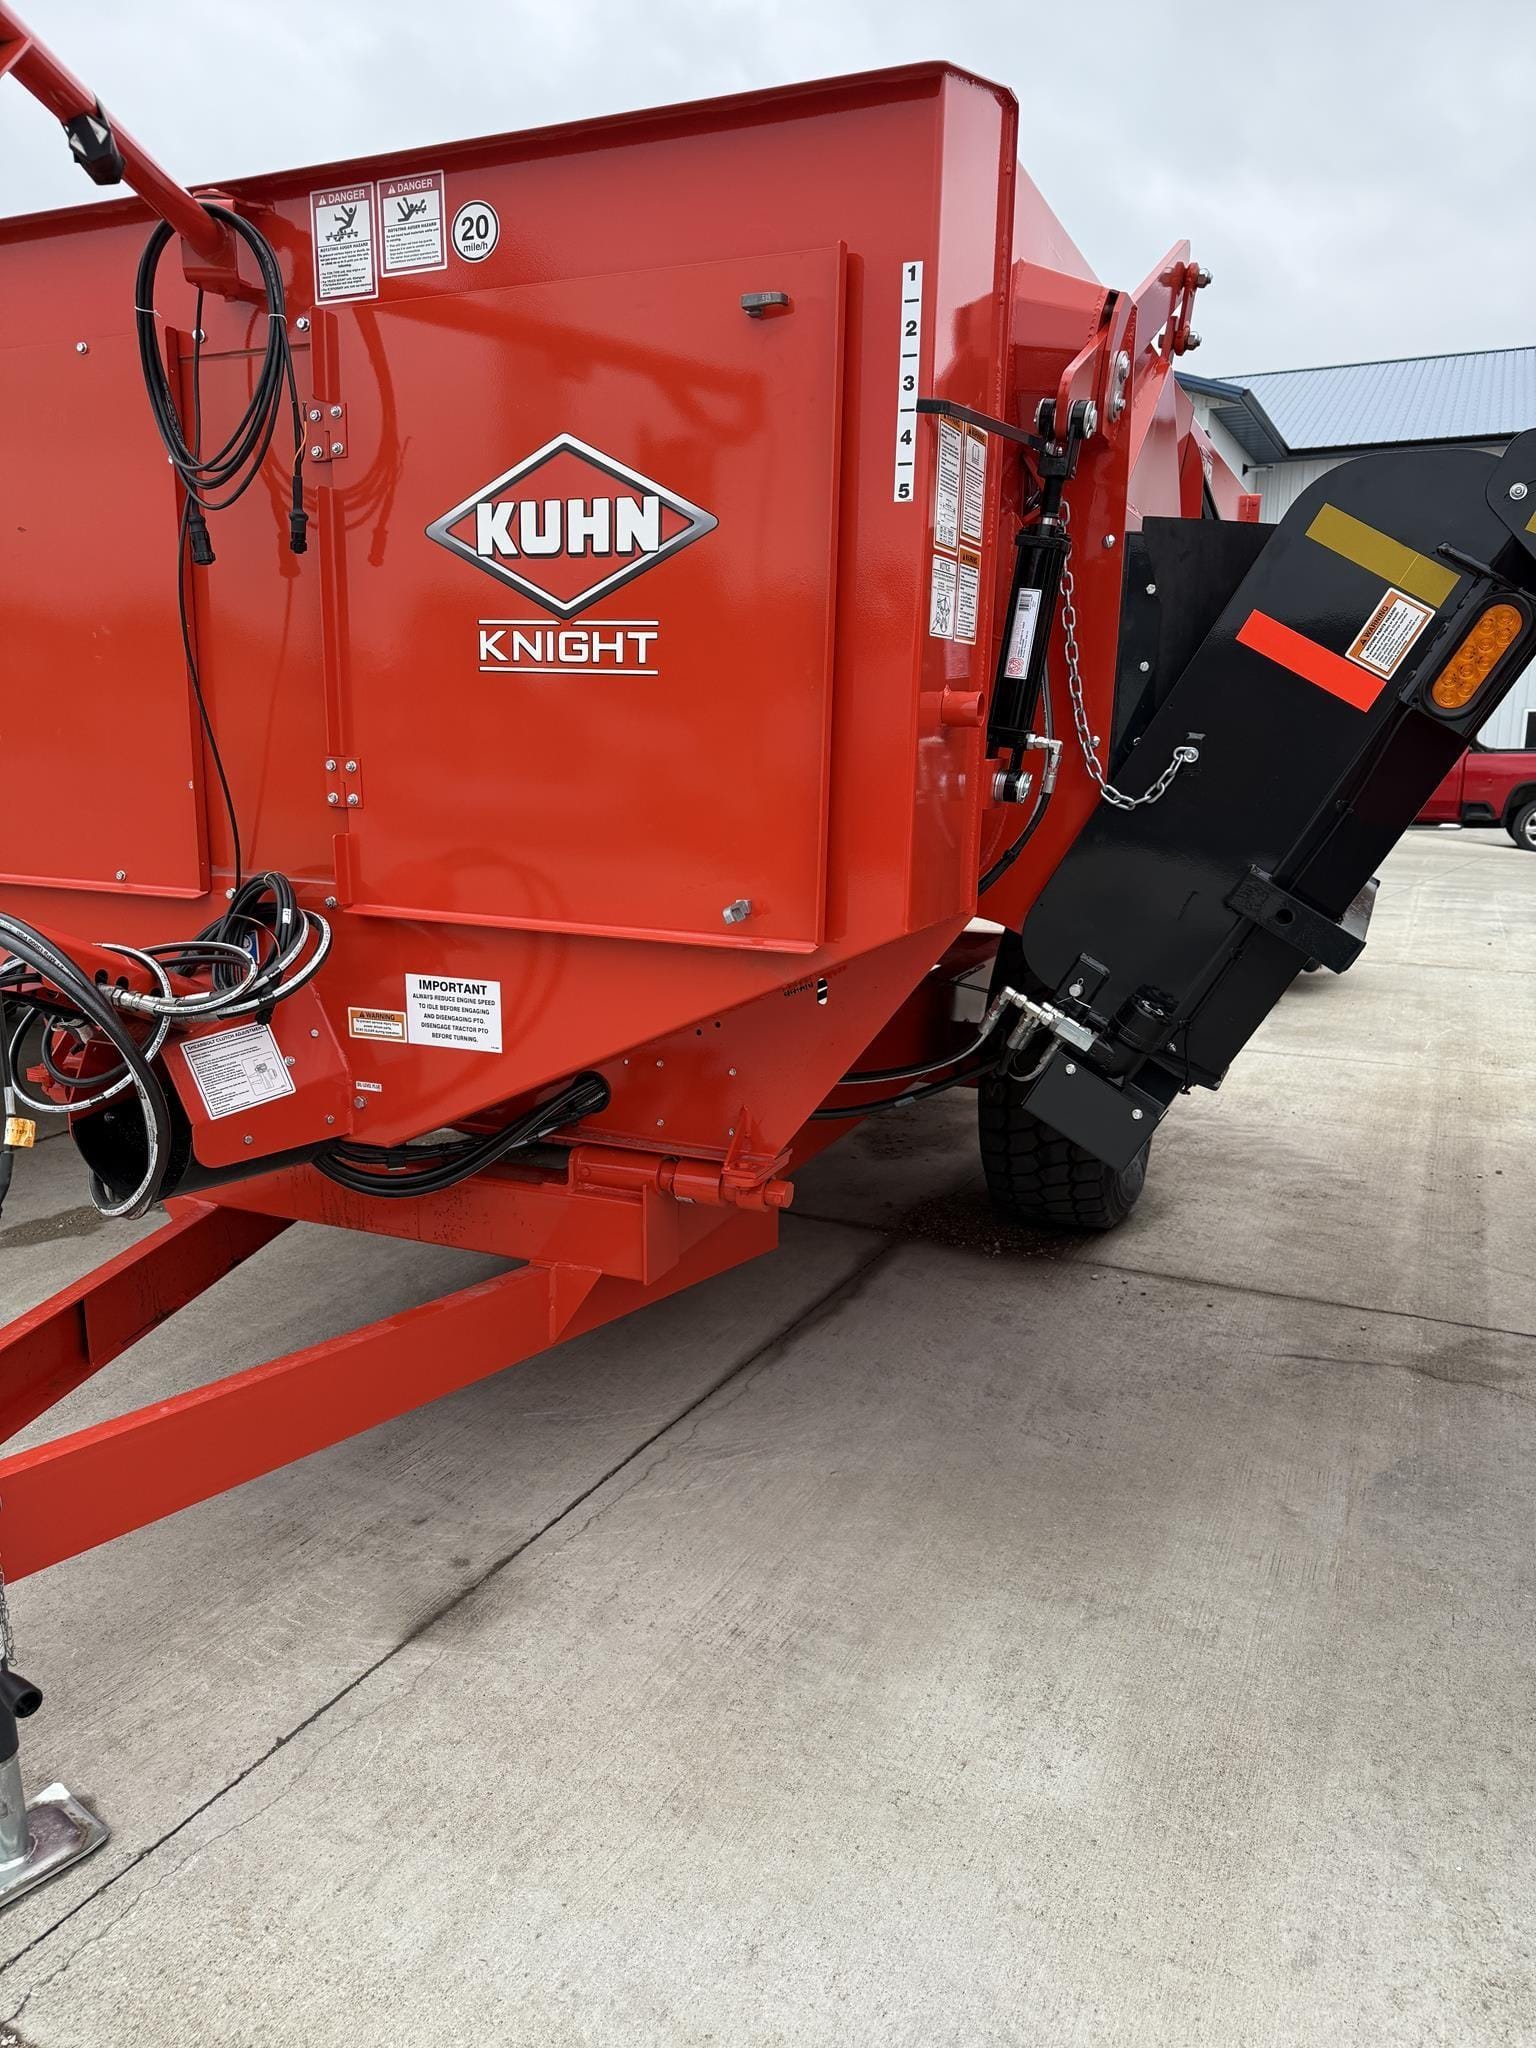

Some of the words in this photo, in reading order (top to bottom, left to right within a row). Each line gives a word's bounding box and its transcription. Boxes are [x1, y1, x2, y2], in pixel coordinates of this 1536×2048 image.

[398, 179, 432, 192] DANGER
[328, 191, 365, 203] DANGER
[462, 215, 489, 241] 20
[464, 242, 488, 252] mile/h
[908, 266, 916, 281] 1
[906, 321, 917, 336] 2
[903, 376, 914, 391] 3
[900, 430, 912, 445] 4
[898, 483, 910, 498] 5
[476, 496, 660, 557] KUHN
[1364, 606, 1389, 638] WARNING
[479, 630, 658, 664] KNIGHT
[418, 979, 487, 995] IMPORTANT
[366, 1012, 395, 1020] WARNING
[436, 1014, 471, 1023] DISENGAGING
[462, 1007, 489, 1015] ENGAGING
[216, 1033, 234, 1042] CLUTCH
[235, 1026, 265, 1037] ADJUSTMENT
[421, 1022, 451, 1031] DISENGAGE
[453, 1024, 476, 1033] TRACTOR
[454, 1034, 478, 1043] TURNING.
